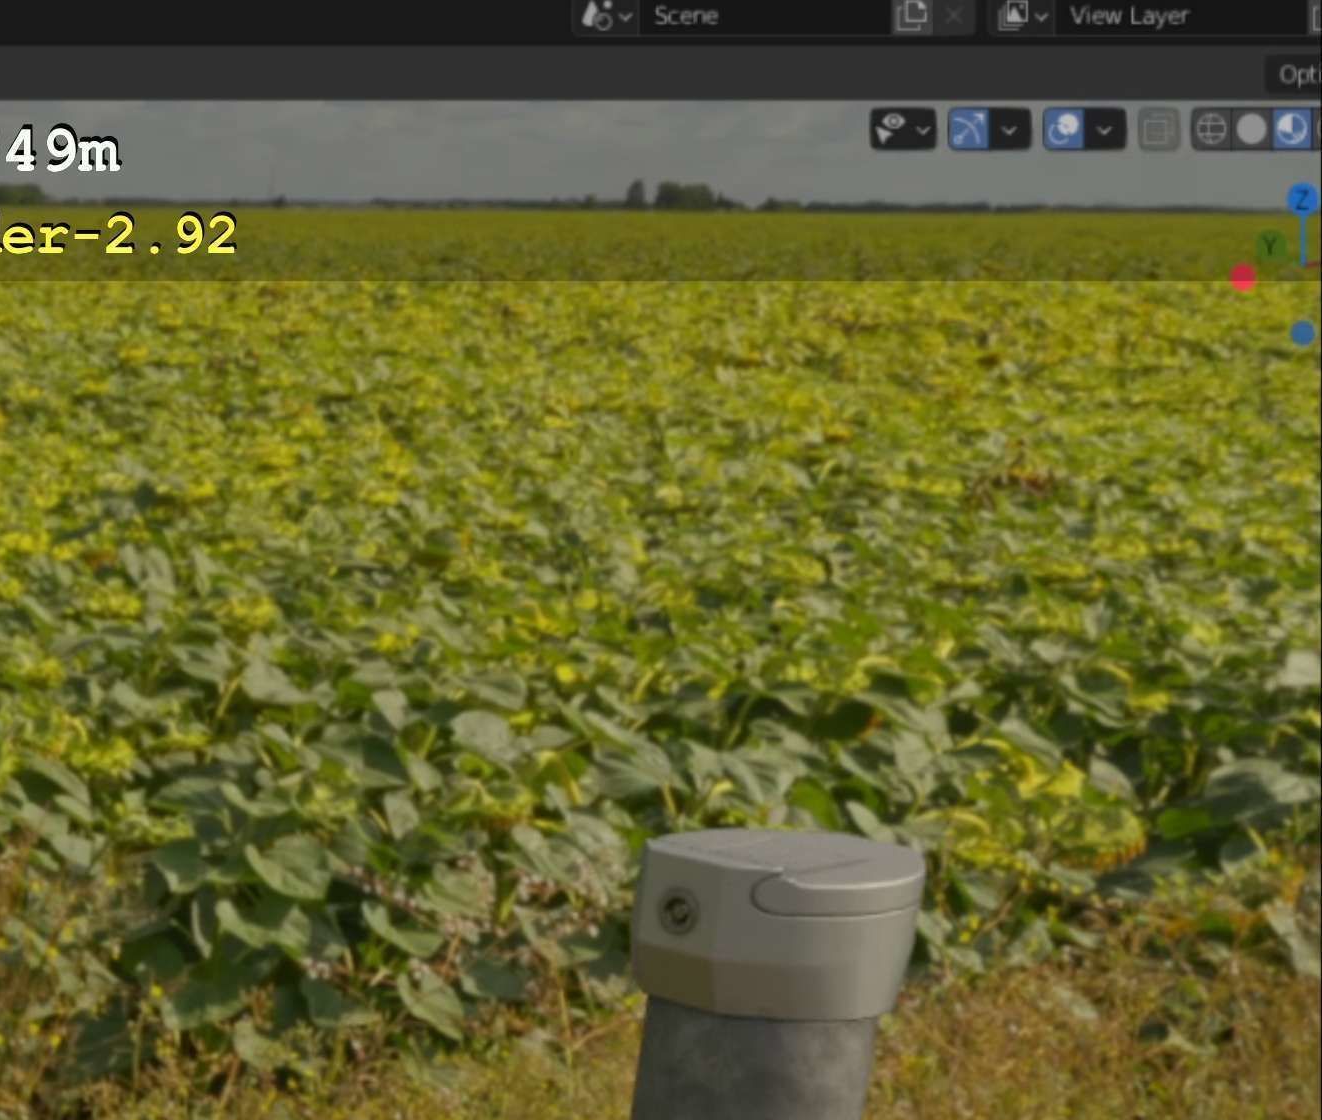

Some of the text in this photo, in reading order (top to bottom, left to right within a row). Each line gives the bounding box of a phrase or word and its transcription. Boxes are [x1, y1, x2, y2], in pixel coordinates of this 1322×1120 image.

[654, 6, 719, 25] Scene
[1071, 6, 1189, 30] View Layer
